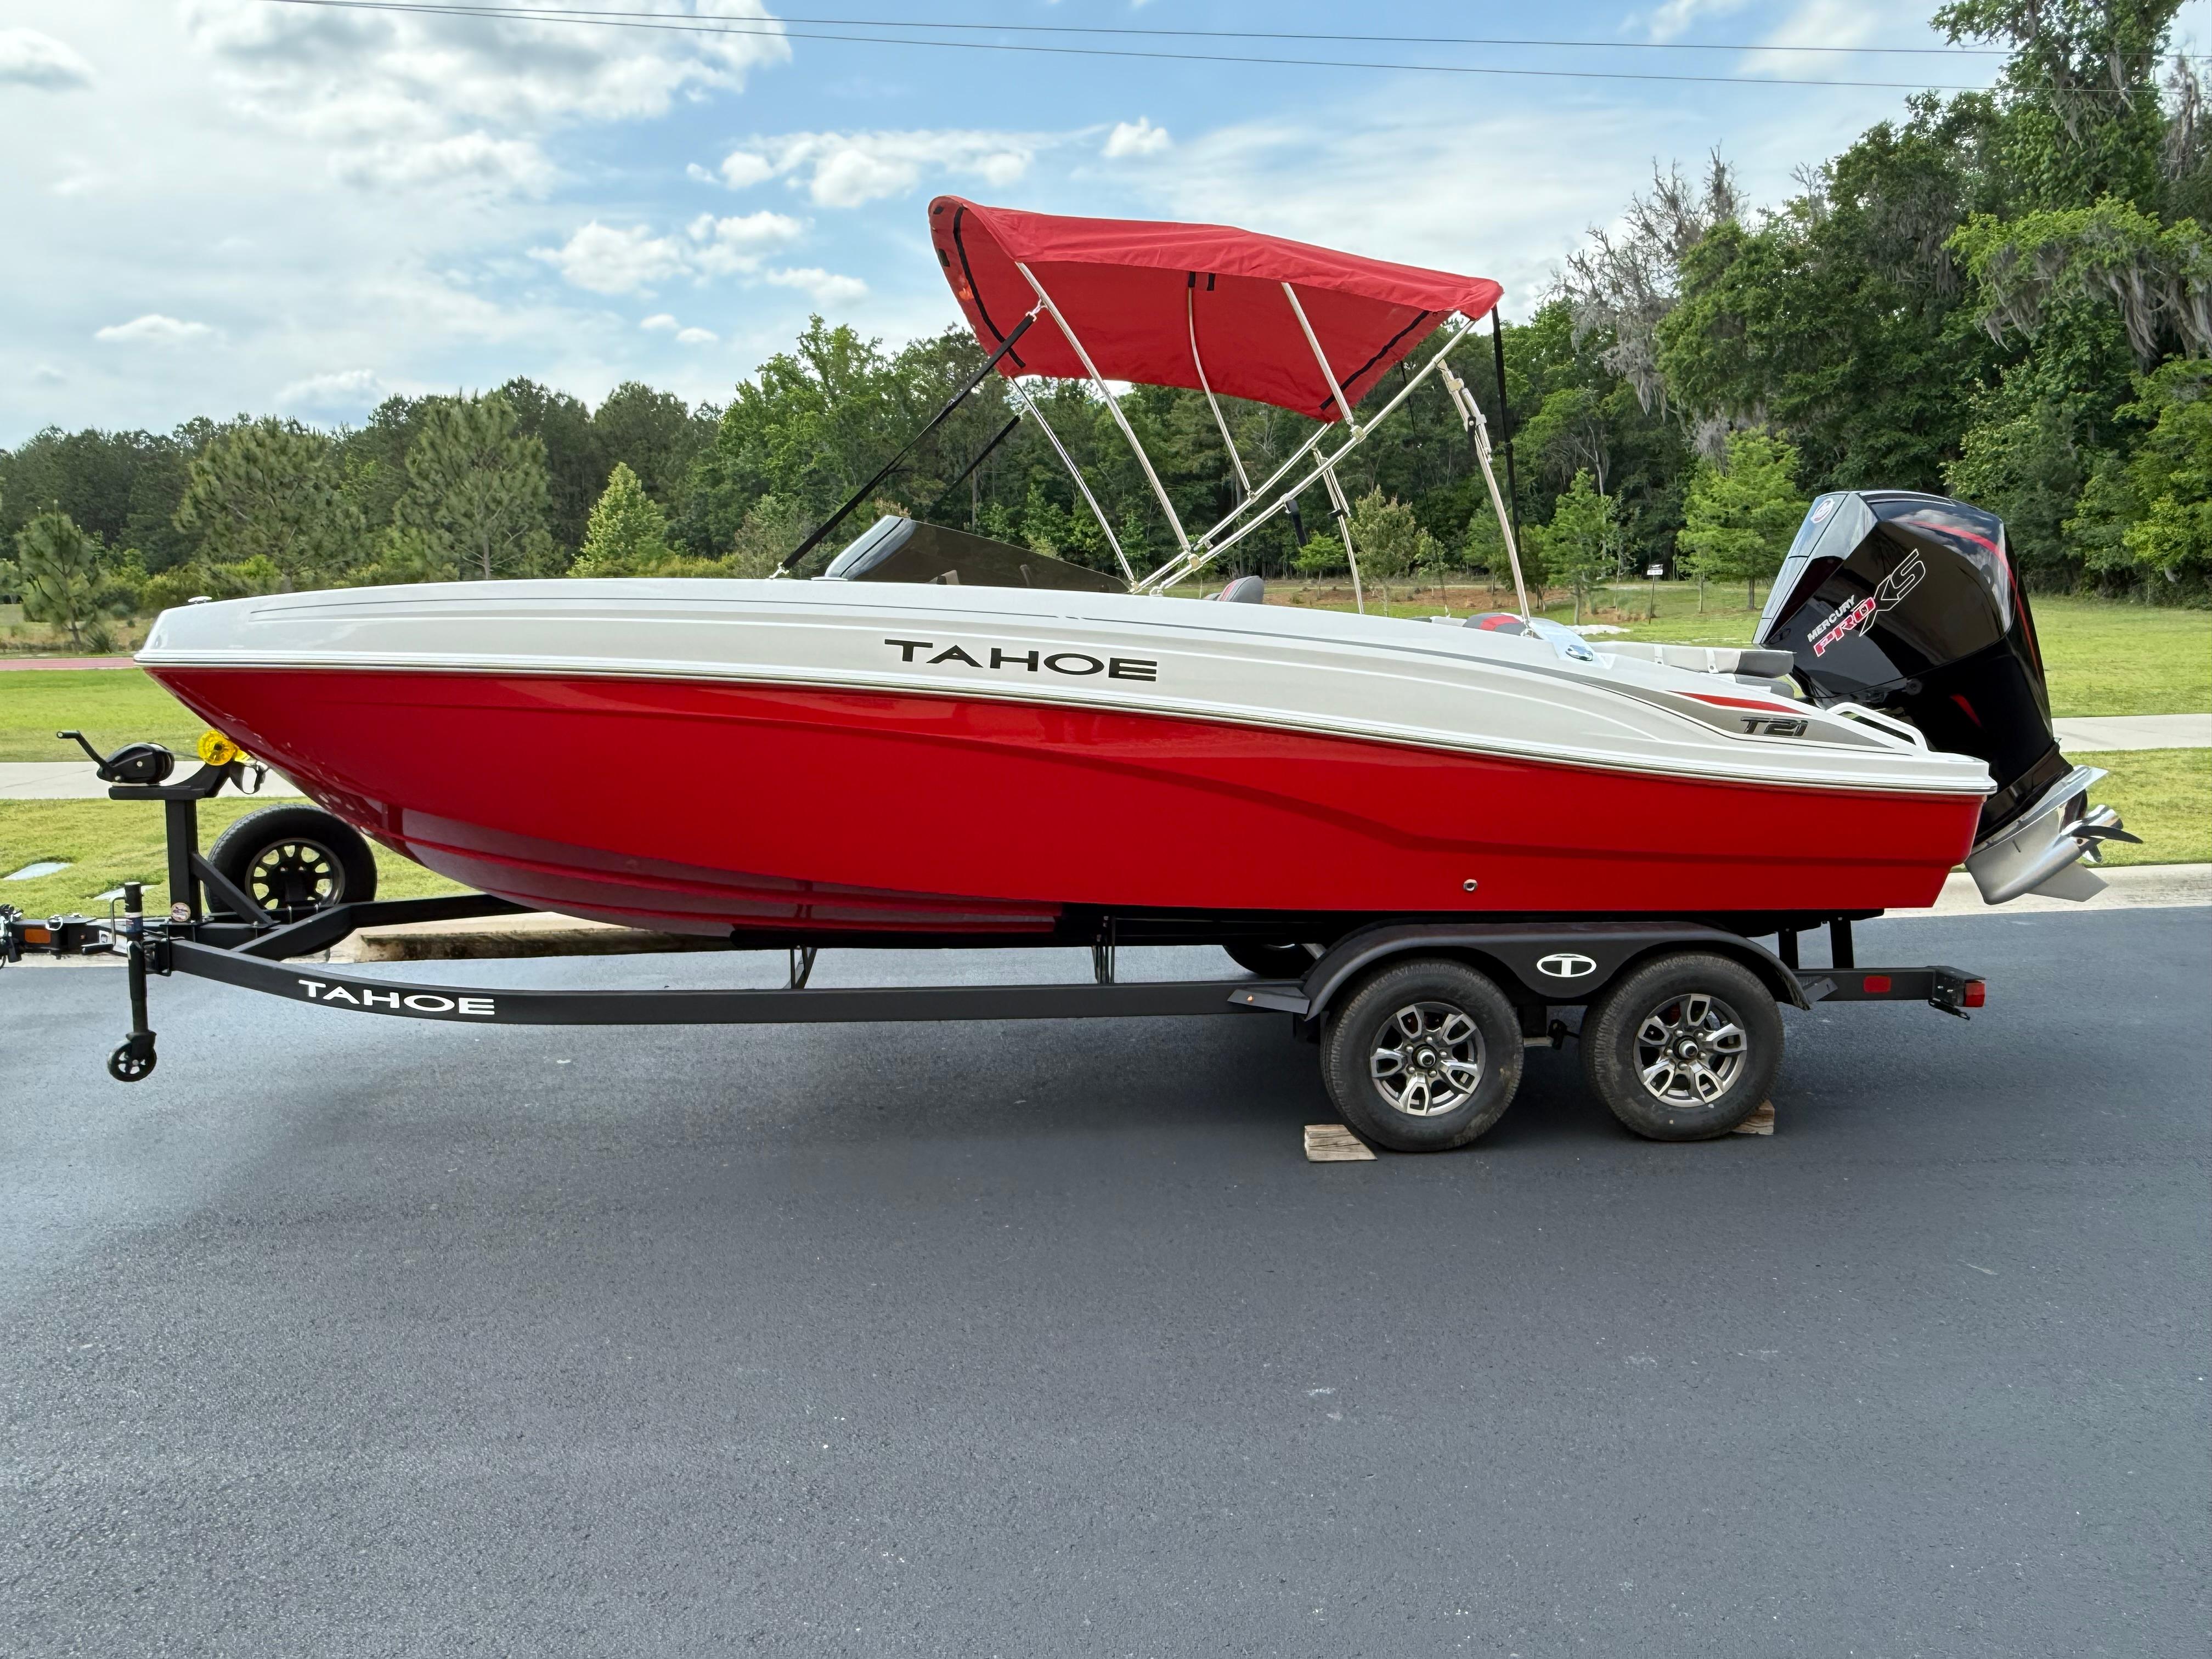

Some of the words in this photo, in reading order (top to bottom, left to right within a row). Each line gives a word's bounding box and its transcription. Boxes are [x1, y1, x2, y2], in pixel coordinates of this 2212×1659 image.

[1807, 595, 1855, 642] MERCURY
[1813, 597, 1876, 657] PRO
[1859, 549, 1926, 637] XS
[884, 639, 1158, 681] TAHOE
[1740, 716, 1809, 736] T21
[298, 979, 495, 1015] TAHOE
